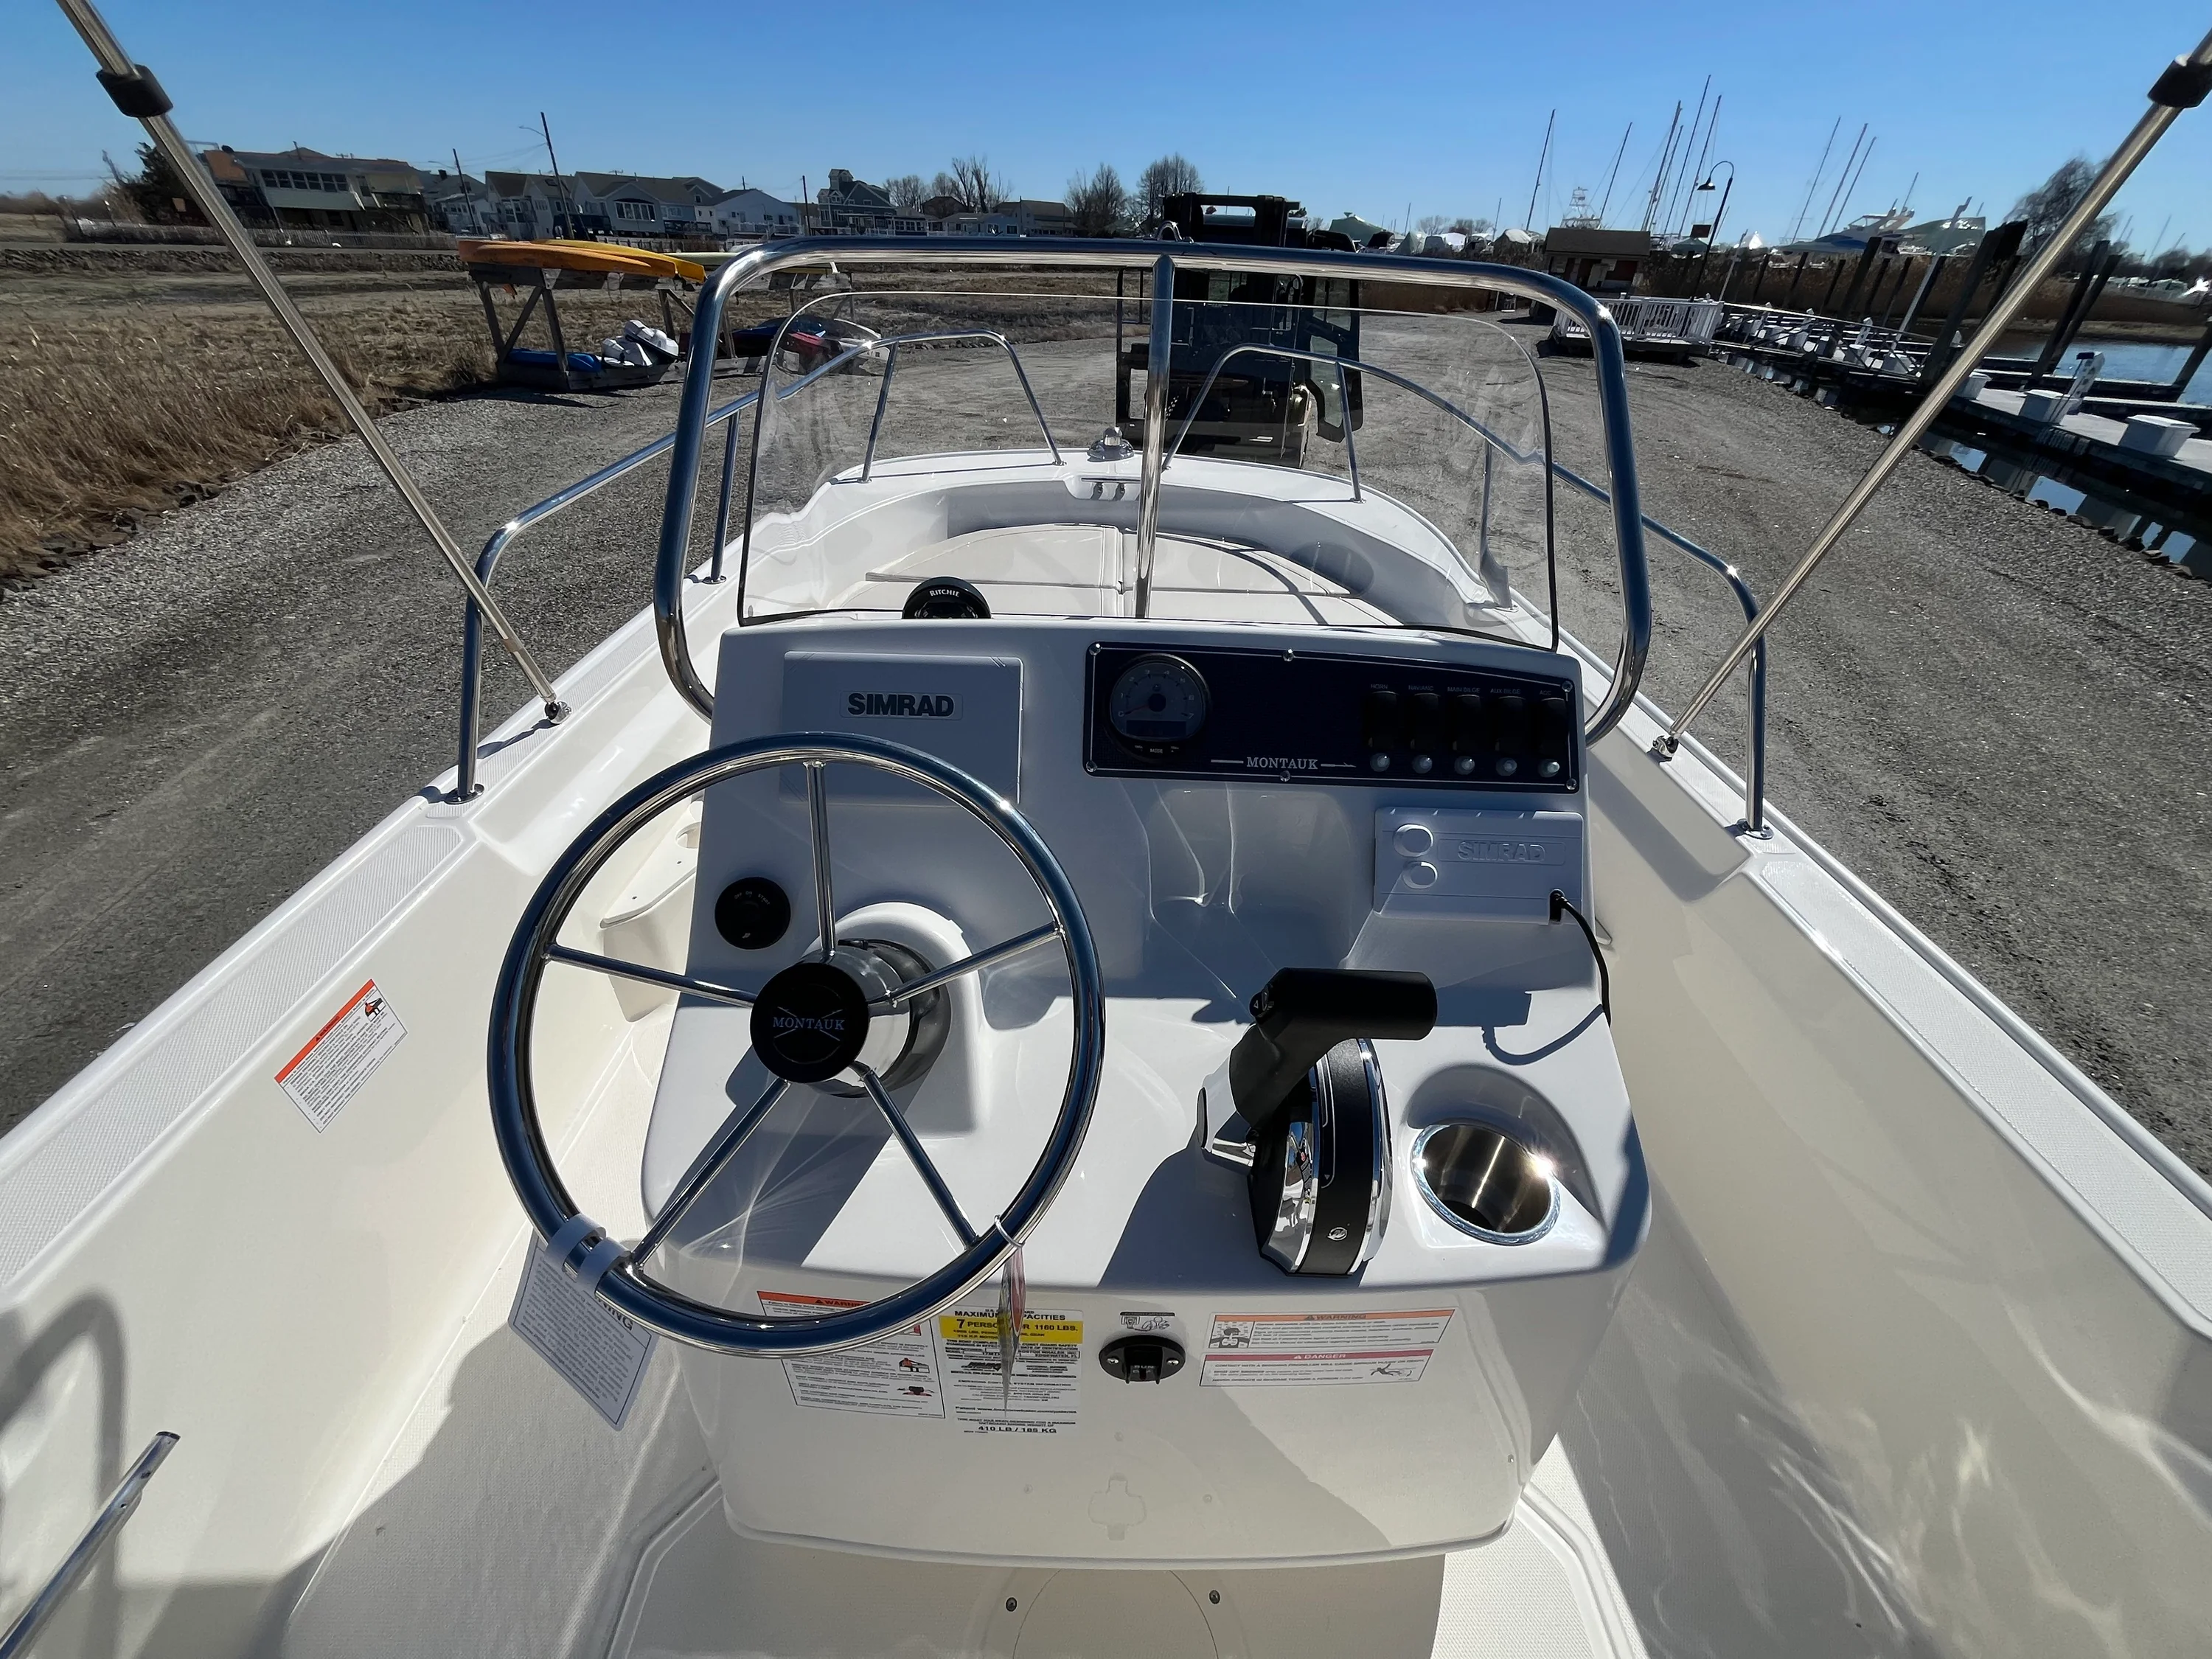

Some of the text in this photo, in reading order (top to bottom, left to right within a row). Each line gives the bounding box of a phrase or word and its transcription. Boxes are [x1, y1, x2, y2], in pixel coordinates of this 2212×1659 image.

[929, 589, 960, 597] RITCHIE
[847, 692, 954, 717] SIMRAD
[1246, 757, 1318, 770] MONTAUK
[1457, 841, 1545, 862] SIMRAD
[773, 1016, 845, 1031] MONTAUK
[824, 1300, 864, 1308] WARNIN
[956, 1318, 965, 1329] 7
